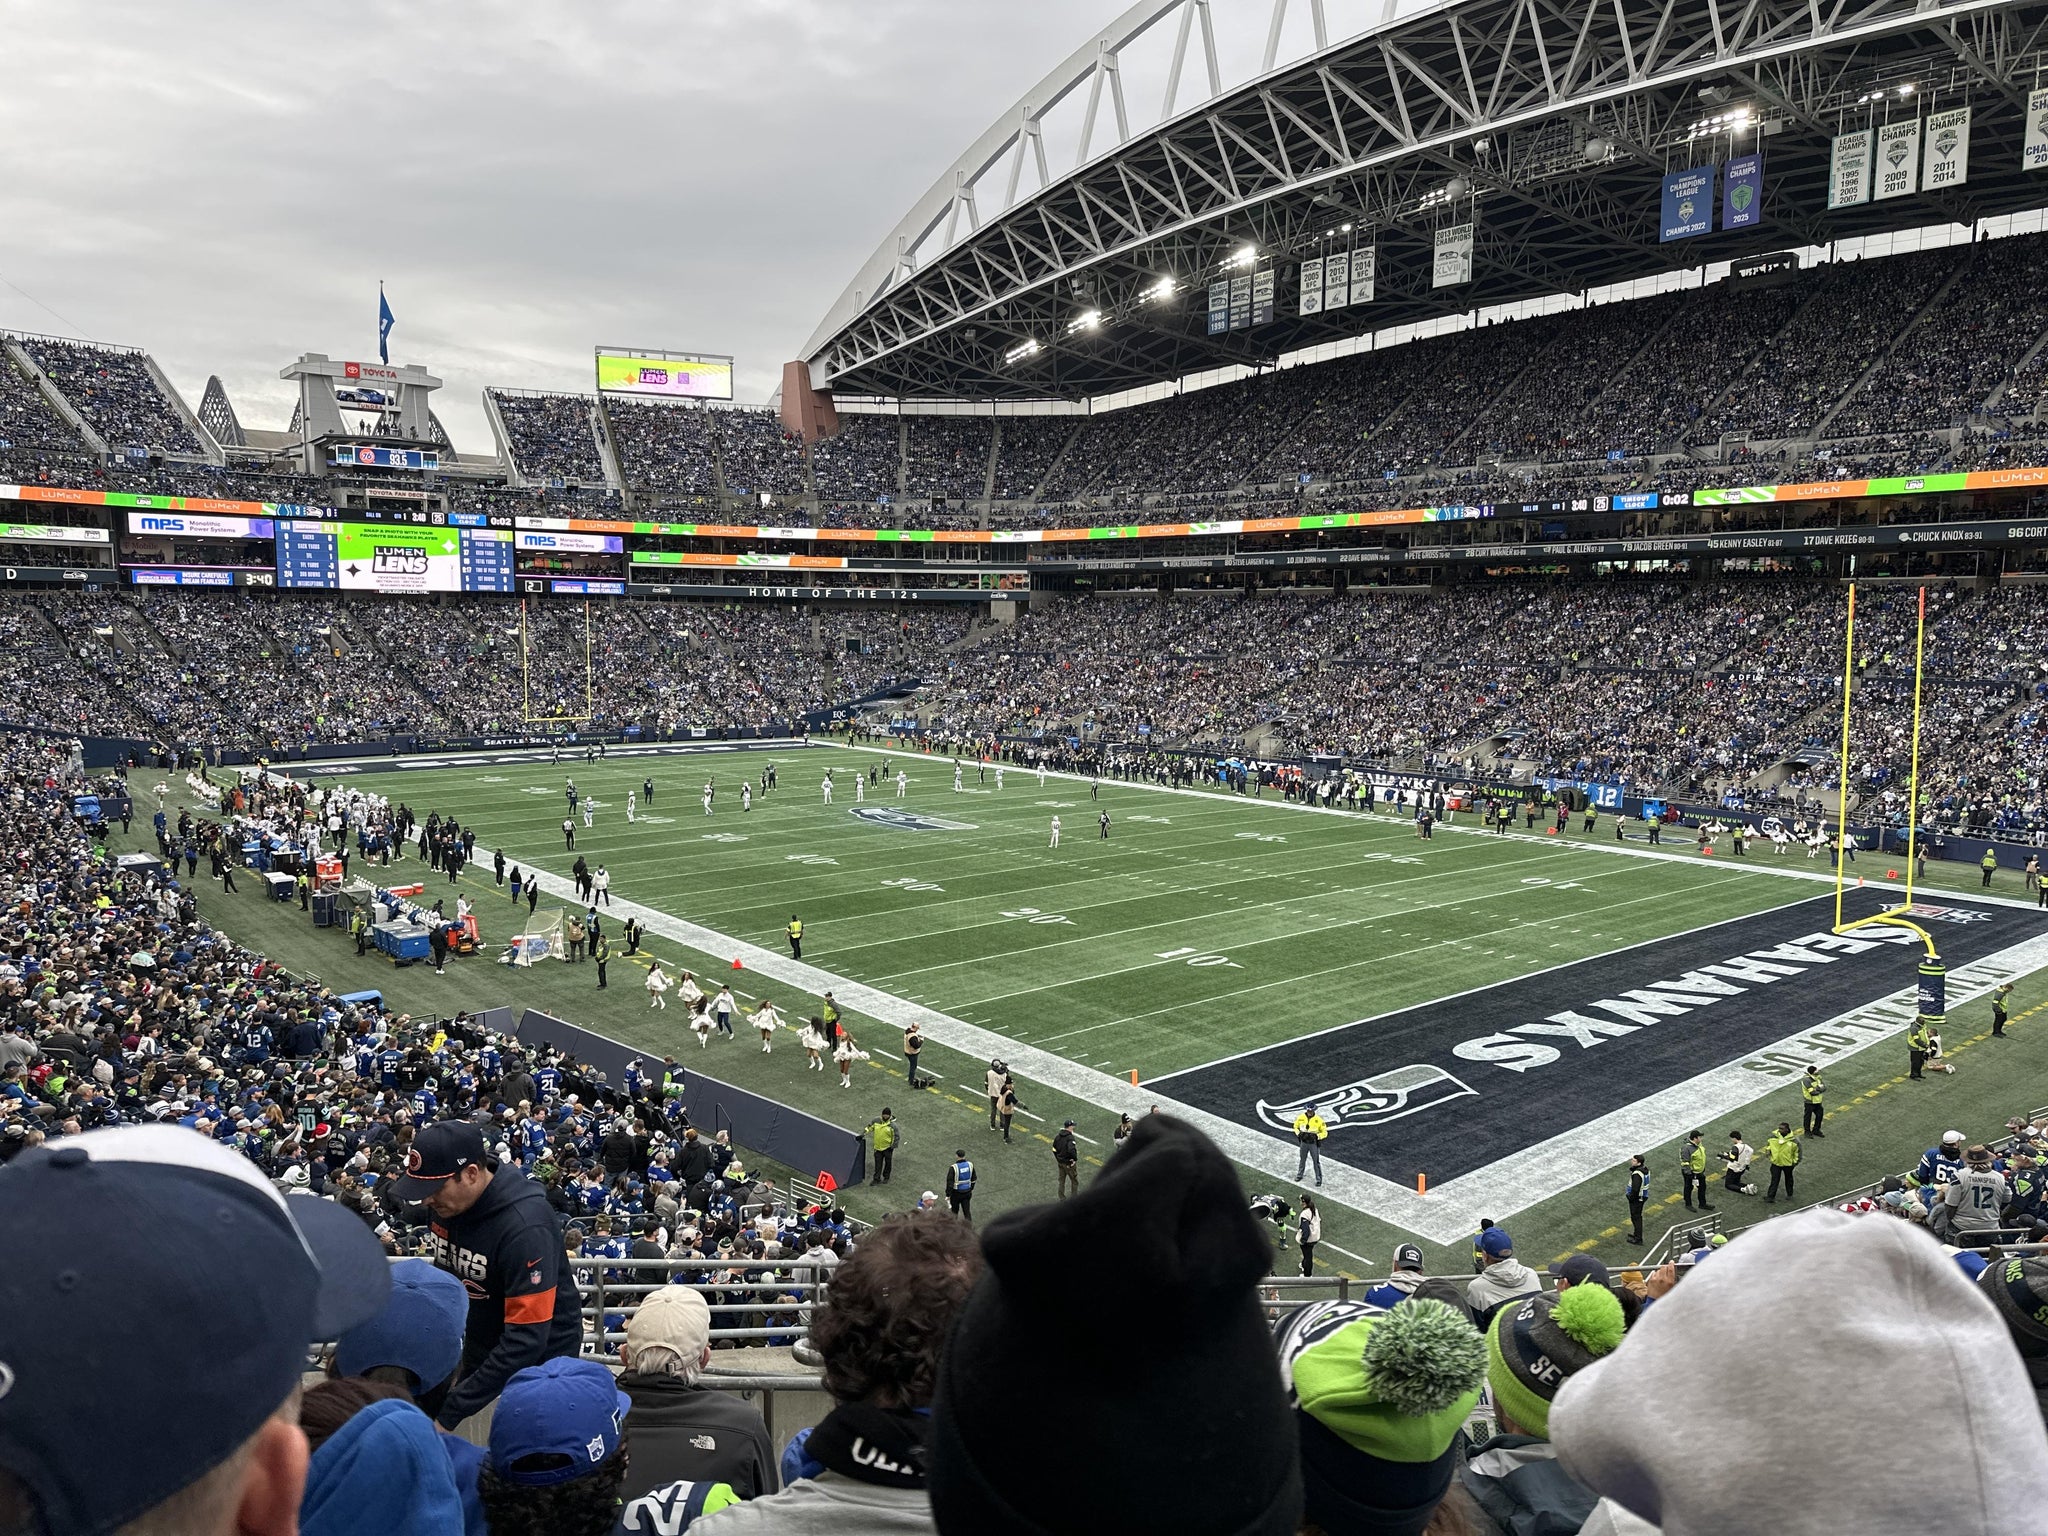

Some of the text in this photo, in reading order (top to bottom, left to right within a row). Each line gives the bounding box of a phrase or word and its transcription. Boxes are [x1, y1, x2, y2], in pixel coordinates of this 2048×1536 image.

[1941, 113, 1955, 121] OPEN
[1929, 116, 1967, 131] CHAMPS
[1839, 134, 1866, 145] LEAGUE
[1881, 127, 1917, 142] CHAMPS
[1837, 140, 1867, 153] CHAMPS
[1729, 165, 1756, 179] CHAMPS
[1933, 160, 1956, 173] 2011
[1841, 170, 1859, 179] 1995
[1884, 170, 1908, 183] 2009
[1932, 171, 1956, 183] 2014
[1669, 177, 1706, 193] CHAMPIONS
[1840, 178, 1859, 188] 1996
[1884, 180, 1907, 193] 2010
[1675, 187, 1699, 198] LEAGUE
[1839, 186, 1858, 196] 2005
[1839, 194, 1858, 204] 2007
[1733, 213, 1749, 223] 2025
[1436, 224, 1472, 239] 2013 WORLD
[1665, 222, 1706, 237] CHAMPS 2022
[1435, 233, 1472, 246] CHAMPIONS
[1355, 260, 1371, 271] 2014
[1356, 270, 1369, 278] NFC
[362, 368, 397, 379] TOYOTA
[639, 373, 667, 384] LENS
[389, 454, 407, 466] 93.5
[1992, 473, 2043, 483] LUMEN
[41, 490, 82, 500] LUMEN
[1797, 486, 1841, 496] LUMEN
[1596, 499, 1606, 509] 25
[1662, 494, 1689, 505] 0:02
[203, 502, 240, 510] LUMEN
[295, 506, 300, 515] 3
[1561, 502, 1565, 511] 1
[1571, 500, 1588, 511] 3:40
[326, 508, 332, 517] 0
[403, 513, 407, 521] 1
[1374, 513, 1405, 521] LUMEN
[1453, 508, 1459, 517] 3
[1483, 506, 1488, 517] 0
[411, 513, 426, 522] 3:40
[490, 517, 512, 526] 0:02
[1912, 530, 1983, 542] CHUCK KNOX 83-91
[2008, 527, 2024, 538] 96
[1707, 538, 1768, 549] 45 KENNY EASLEY
[1803, 534, 1875, 545] 17 DAVE KRIEG 80-91
[375, 547, 424, 556] LUMEN
[1573, 545, 1591, 553] ALLEN
[1622, 542, 1674, 551] 79 JACOB GREEN
[1348, 554, 1360, 562] DAVE
[1408, 552, 1421, 560] PETE
[1465, 548, 1513, 557] 28 CURT WARNER
[374, 555, 428, 573] LENS
[1245, 558, 1264, 566] LARGENT
[1303, 556, 1316, 564] ZORN
[6, 569, 17, 580] D
[246, 573, 273, 585] 3:40
[749, 588, 918, 599] HOME OF THE 12s
[832, 710, 847, 719] EQC
[1599, 786, 1617, 807] 12
[880, 877, 940, 892] 30
[998, 907, 1068, 925] 20
[1153, 946, 1230, 968] 10
[1452, 922, 1932, 1073] SEAHAWKS
[247, 1034, 261, 1048] 12
[1796, 1031, 1858, 1055] OF
[383, 1061, 398, 1073] 23
[481, 1057, 490, 1069] 10
[1741, 1052, 1804, 1077] US
[541, 1079, 554, 1091] 21
[413, 1101, 425, 1115] 99
[599, 1124, 612, 1137] 29
[818, 1174, 829, 1187] G
[2024, 1171, 2031, 1179] 3
[1971, 1185, 1995, 1209] 12
[430, 1231, 488, 1281] BEARS
